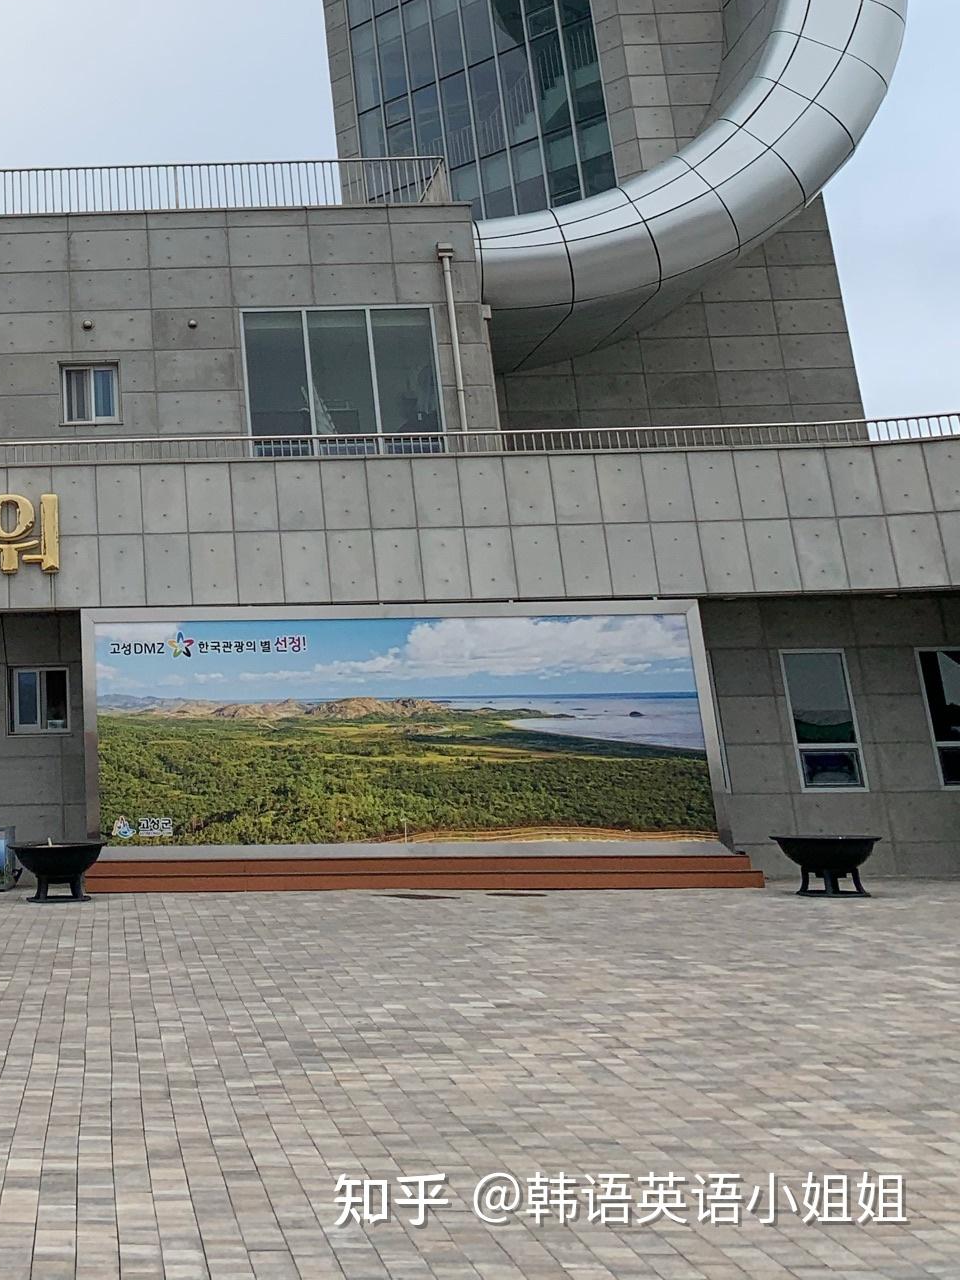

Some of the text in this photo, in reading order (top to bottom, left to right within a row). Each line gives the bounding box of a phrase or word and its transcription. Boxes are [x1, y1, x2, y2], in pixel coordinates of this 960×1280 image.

[198, 640, 257, 654] 한국관광의
[260, 640, 272, 653] 별
[273, 636, 307, 653] 선정!
[139, 818, 173, 830] 고성군
